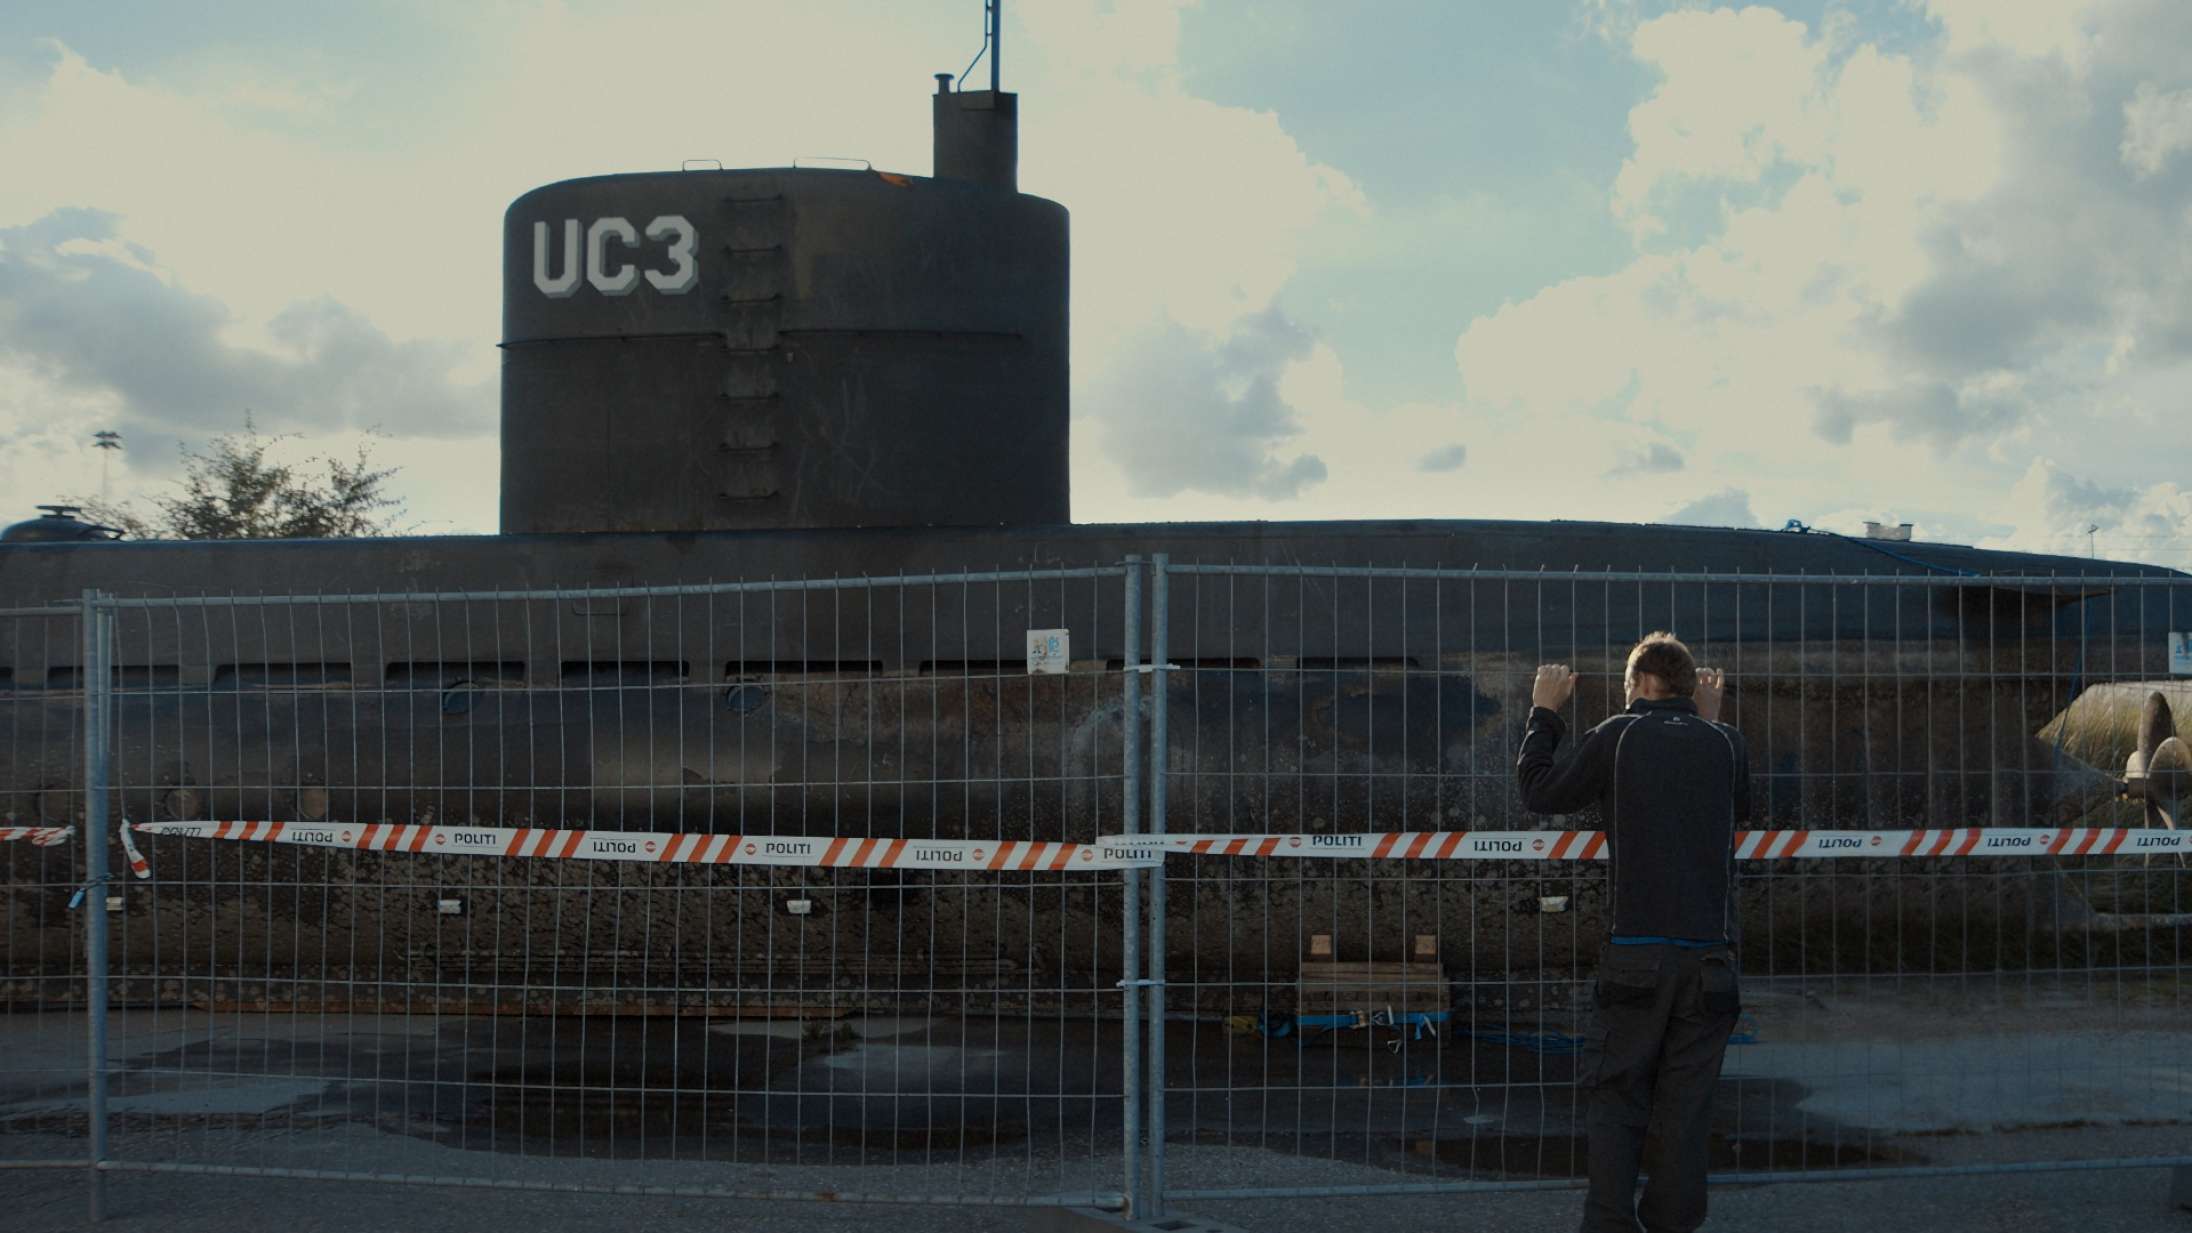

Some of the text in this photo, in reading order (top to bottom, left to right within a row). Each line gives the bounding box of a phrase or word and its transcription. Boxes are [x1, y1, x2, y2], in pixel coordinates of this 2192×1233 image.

[533, 215, 699, 298] UC3
[292, 831, 333, 843] POLITI
[454, 833, 496, 845] POLITI
[1312, 835, 1362, 846] POLITI
[1987, 837, 2032, 847] POLITI
[2136, 837, 2181, 847] POLITI
[593, 841, 636, 853] POLITI
[766, 842, 811, 854] POLITI
[1474, 841, 1522, 852] POLITI
[1818, 838, 1864, 849] POLITI
[916, 850, 963, 862] POLITI
